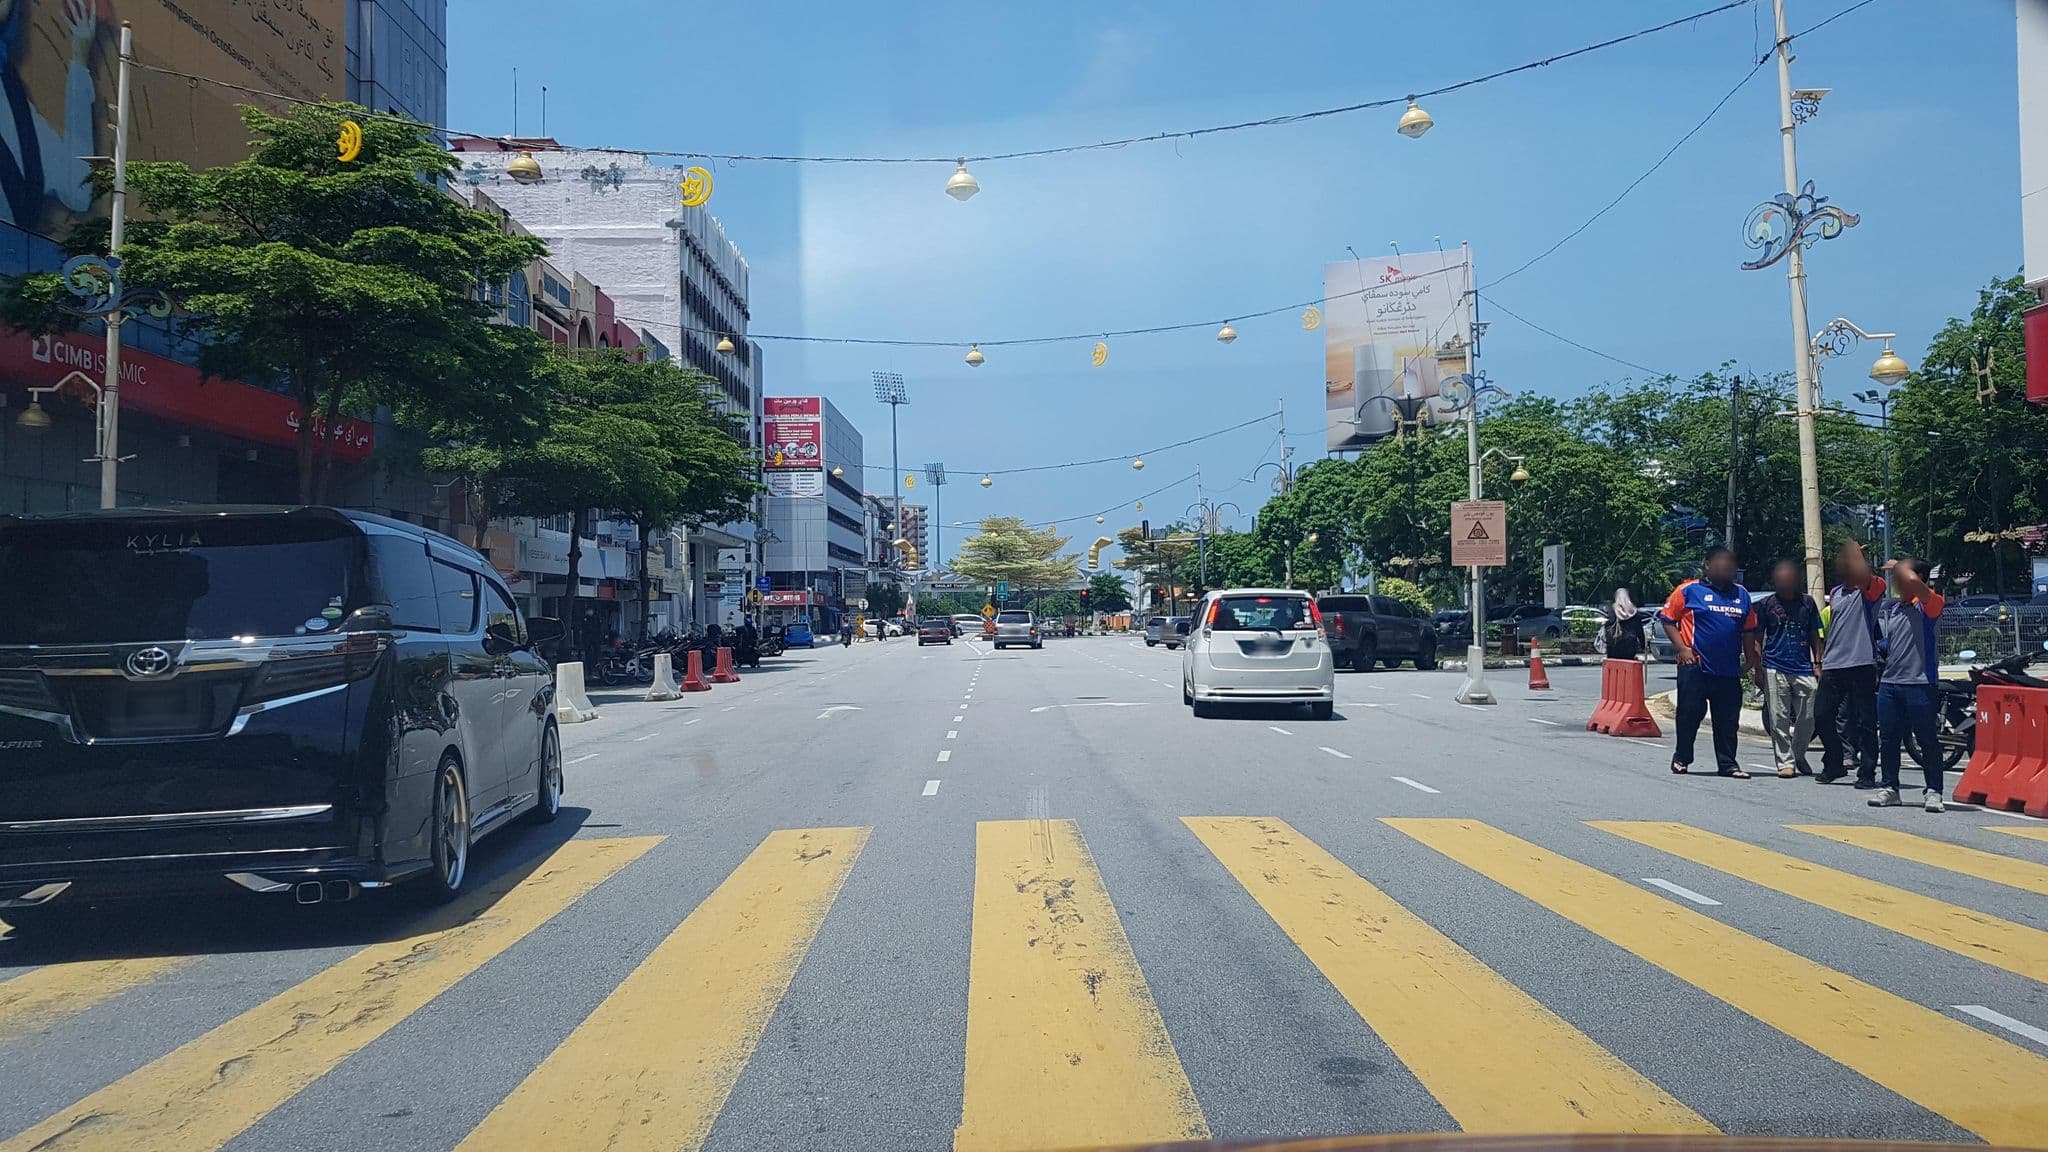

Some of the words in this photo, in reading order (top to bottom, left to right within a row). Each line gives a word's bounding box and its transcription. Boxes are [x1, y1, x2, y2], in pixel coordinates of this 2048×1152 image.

[1379, 275, 1392, 284] SK
[54, 341, 92, 370] CIMB
[94, 354, 147, 385] ISAMIC
[126, 533, 202, 548] KYLIA
[1708, 605, 1743, 614] TELEKOM
